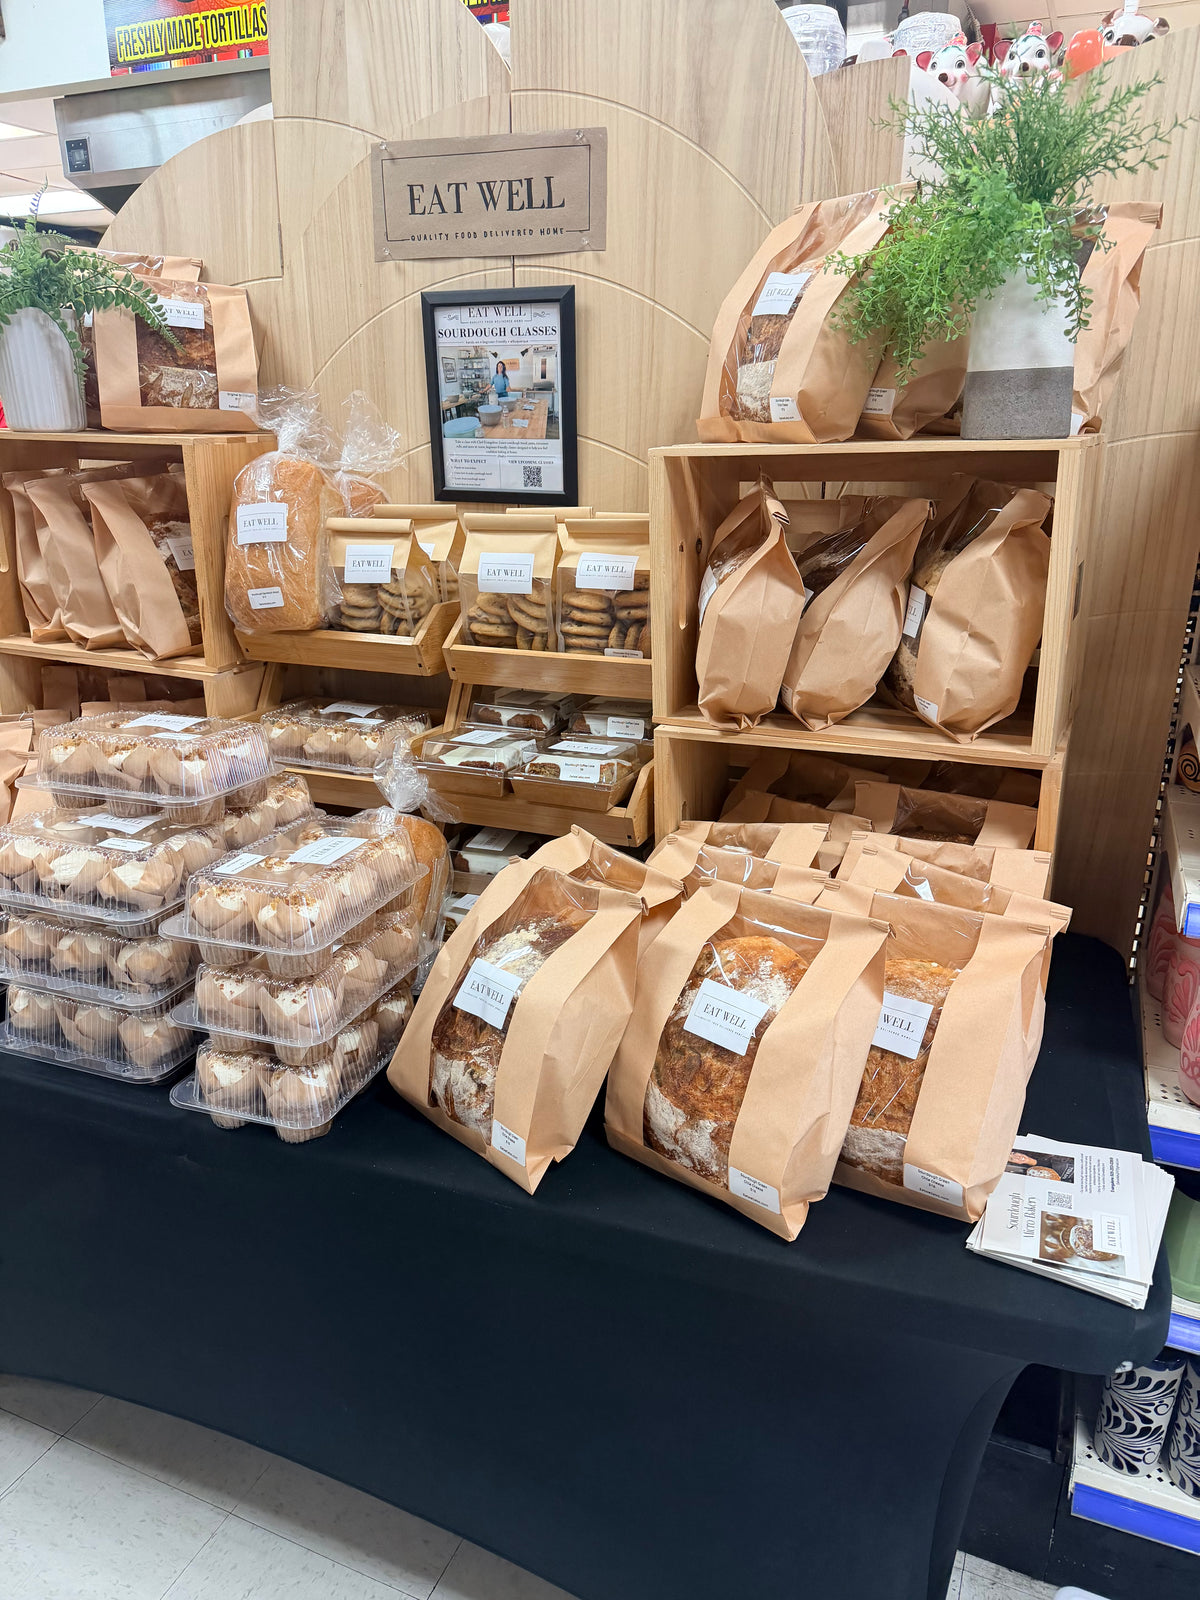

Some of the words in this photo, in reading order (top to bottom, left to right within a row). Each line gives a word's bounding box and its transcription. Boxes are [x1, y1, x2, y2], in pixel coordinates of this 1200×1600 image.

[117, 23, 164, 59] FRESHLY
[167, 17, 201, 50] MADE
[202, 5, 268, 45] TORTILLAS
[407, 182, 468, 215] EAT
[476, 176, 565, 212] WELL
[410, 233, 449, 241] QUALITY
[455, 231, 478, 239] FOOD
[483, 229, 533, 238] DELIVERED
[540, 227, 564, 236] HOME
[468, 306, 490, 318] EAT
[493, 305, 527, 317] WELL
[438, 327, 507, 339] SOURDOUGH
[510, 325, 557, 337] CLASSES
[243, 519, 255, 529] EAT
[256, 517, 279, 527] WELL
[352, 559, 368, 568] EAT
[367, 559, 385, 568] WELL
[586, 564, 603, 572] EAT
[604, 564, 627, 573] WELL
[486, 568, 502, 576] EAT
[503, 569, 525, 577] WELL
[470, 980, 486, 994] EAT
[486, 986, 504, 1005] WELL
[703, 1003, 722, 1018] EAT
[722, 1011, 747, 1030] WELL
[883, 1013, 914, 1033] WELL
[1007, 1191, 1024, 1230] Sourdough
